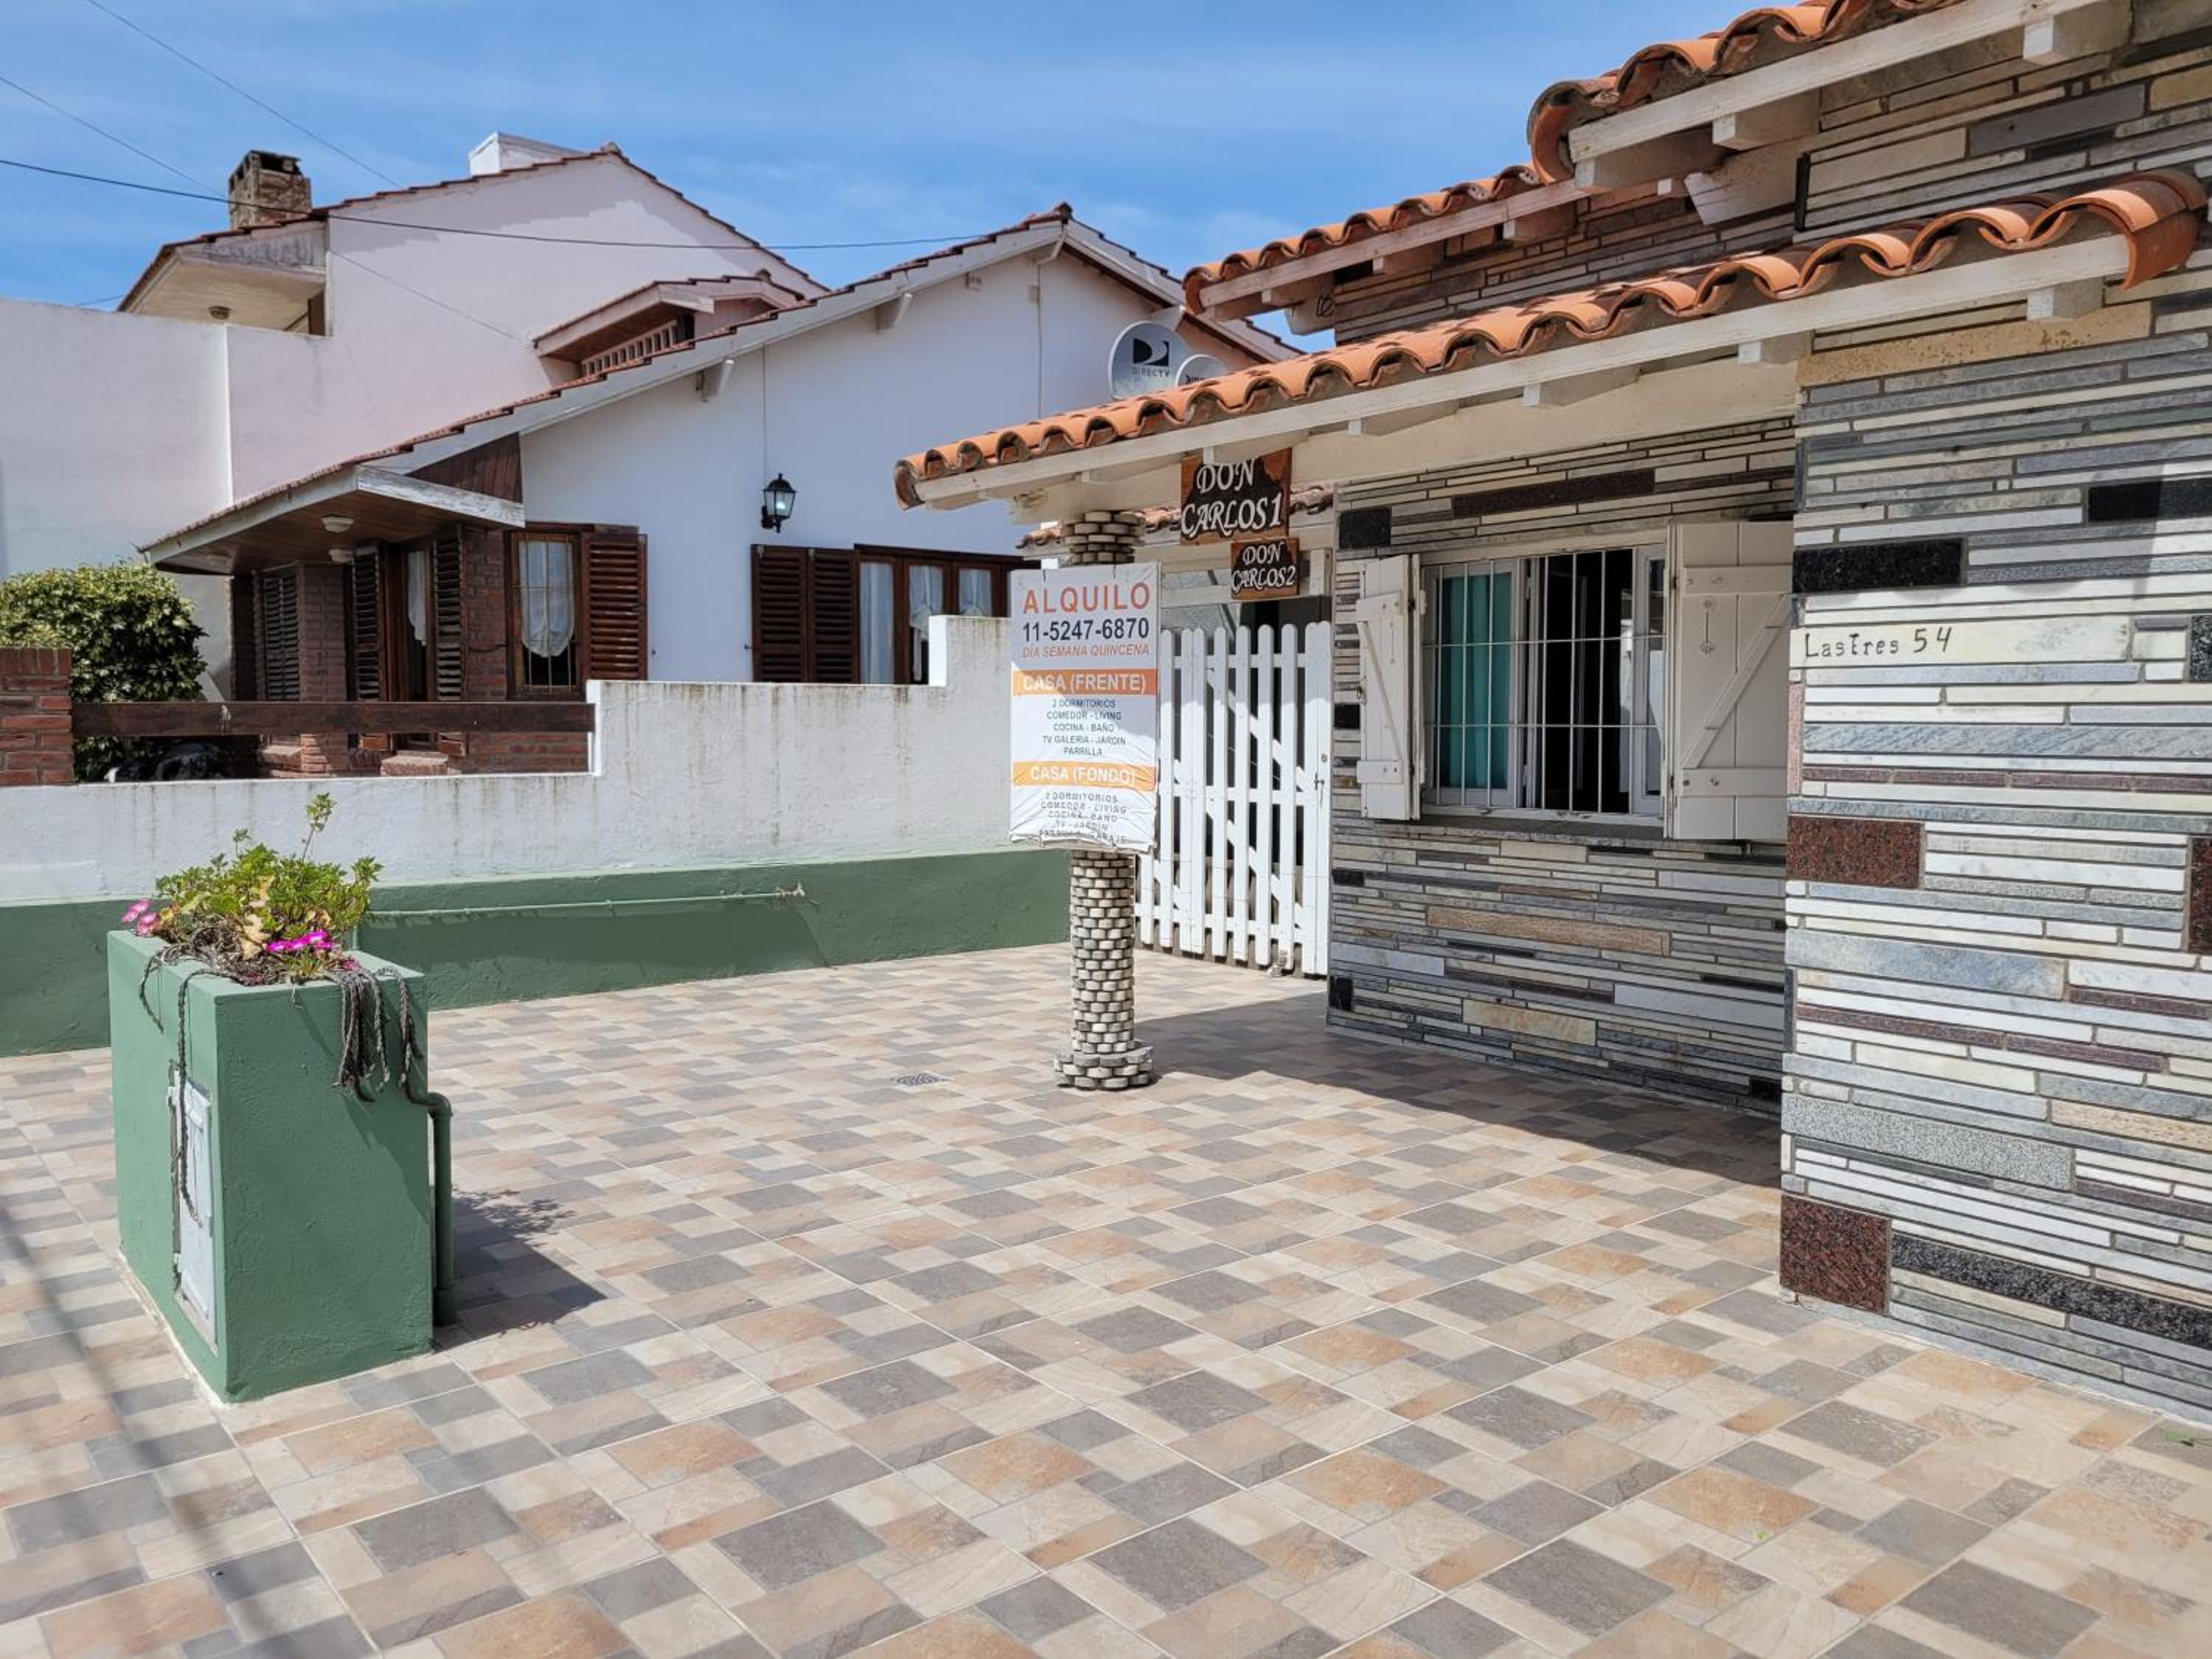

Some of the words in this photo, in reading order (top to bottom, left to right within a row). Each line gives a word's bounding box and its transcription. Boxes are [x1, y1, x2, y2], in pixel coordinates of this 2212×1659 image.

[1133, 367, 1170, 378] DIRECTV
[1196, 459, 1254, 494] DON
[1180, 492, 1282, 538] CARLOS1
[1242, 541, 1284, 566] DON
[1231, 566, 1296, 593] CARLOS2
[1023, 582, 1150, 614] ALQUILO
[1023, 617, 1150, 642] 11-5247-6870
[1022, 647, 1040, 658] DIA
[1042, 646, 1088, 657] SEMANA
[1091, 643, 1150, 657] QUINCENA
[1023, 674, 1066, 692] CASA
[1069, 672, 1147, 694] (FRENTE)
[1058, 698, 1116, 709] DORMITORIOS
[1046, 711, 1088, 720] COMEDOR
[1095, 711, 1121, 720] LIVING
[1053, 723, 1085, 732] COCINA
[1043, 735, 1052, 743] TV
[1054, 735, 1089, 744] GALERIA
[1096, 736, 1126, 745] JARDIN
[1063, 747, 1103, 756] PARRILLA
[1031, 765, 1069, 781] CASA
[1052, 791, 1119, 804] DORMITORIOS
[1040, 801, 1086, 810] COMEDOR
[1093, 804, 1127, 815] LIVING
[1048, 810, 1083, 820] COCINA
